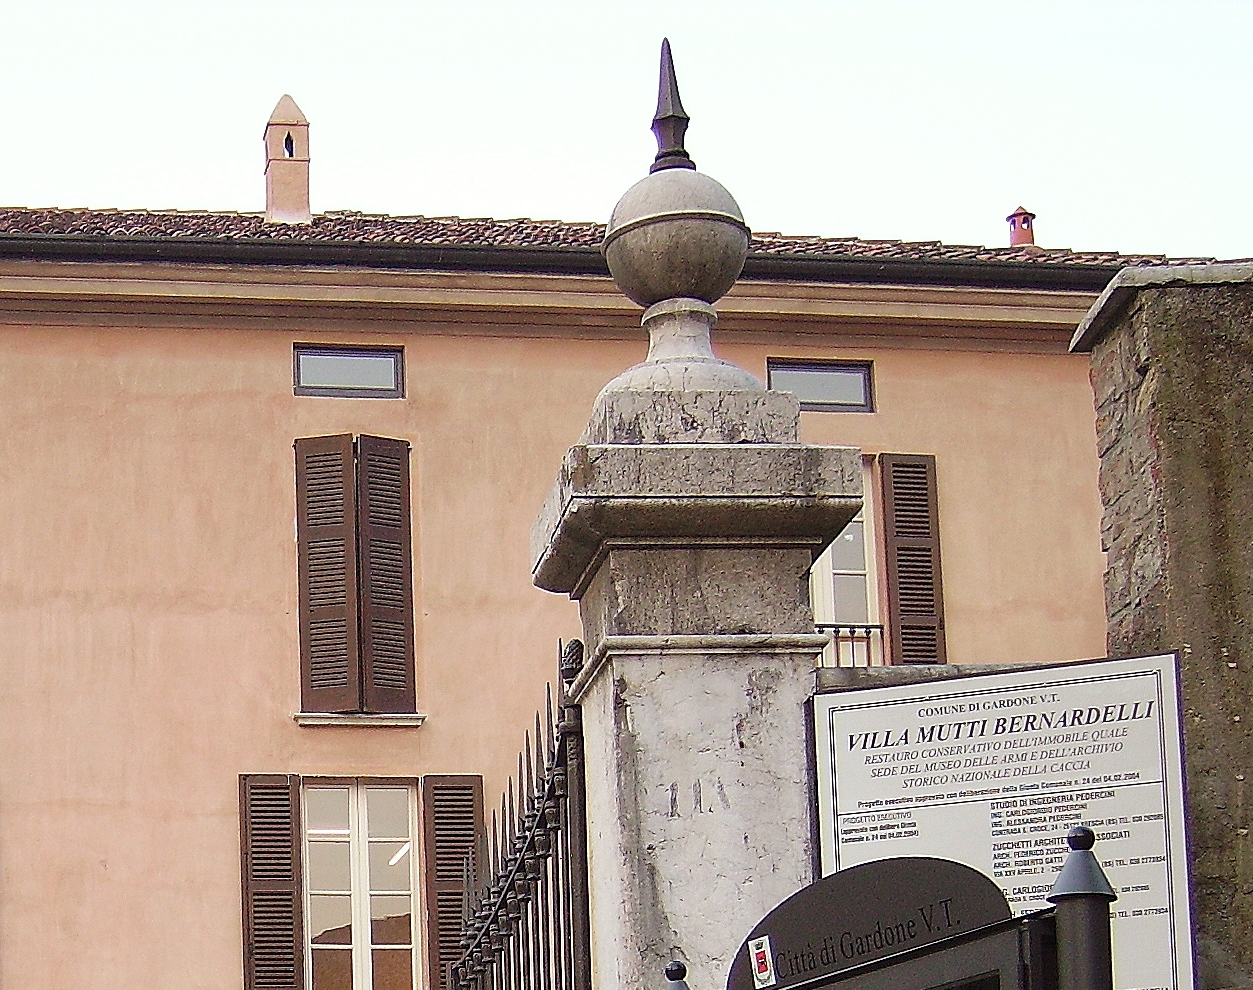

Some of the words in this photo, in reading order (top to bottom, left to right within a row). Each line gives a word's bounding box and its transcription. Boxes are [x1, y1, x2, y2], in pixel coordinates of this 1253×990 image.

[917, 703, 966, 718] COMUNE
[968, 702, 980, 713] DI
[982, 694, 1037, 711] GARDONE
[1039, 694, 1060, 705] V.T.
[847, 728, 909, 751] VILLA
[916, 719, 988, 744] MUTTI
[992, 701, 1155, 736] BERNARDELLI
[864, 750, 919, 765] RESTAURO
[921, 740, 1002, 759] CONSERVATIVO
[1003, 731, 1089, 751] DELL'IMMOBILE
[1091, 727, 1129, 742] QUALE
[870, 766, 898, 778] SEDE
[900, 763, 922, 775] DEL
[925, 759, 961, 773] MUSEO
[963, 755, 999, 769] DELLE
[1001, 752, 1029, 765] ARMI
[1030, 750, 1038, 761] E
[1040, 742, 1124, 760] DELL'ARCHIVIO
[902, 775, 948, 789] STORICO
[950, 768, 1011, 784] NAZIONALE
[1012, 763, 1047, 777] DELLA
[1050, 760, 1092, 774] CACCIA
[990, 799, 1018, 811] STUDIO
[775, 943, 817, 980] Città
[820, 937, 838, 969] di
[839, 920, 916, 960] Gardone
[917, 898, 961, 934] V.T.
